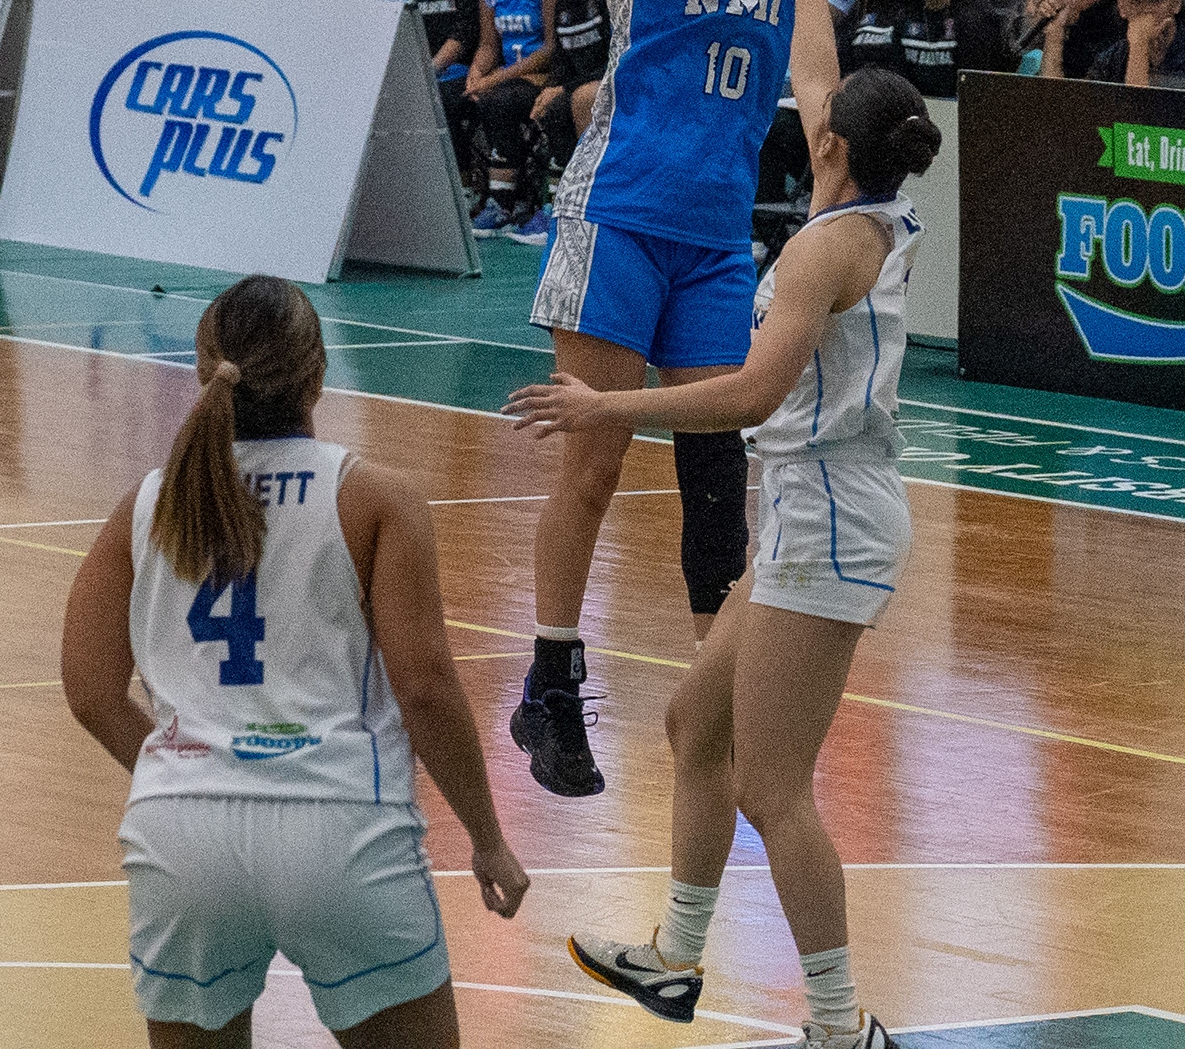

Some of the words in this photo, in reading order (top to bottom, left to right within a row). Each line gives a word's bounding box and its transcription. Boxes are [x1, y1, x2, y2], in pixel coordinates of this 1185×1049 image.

[125, 60, 263, 125] CARS
[704, 41, 752, 101] 10
[139, 119, 285, 198] PLUS
[1127, 130, 1155, 170] Eat,
[186, 571, 266, 687] 4
